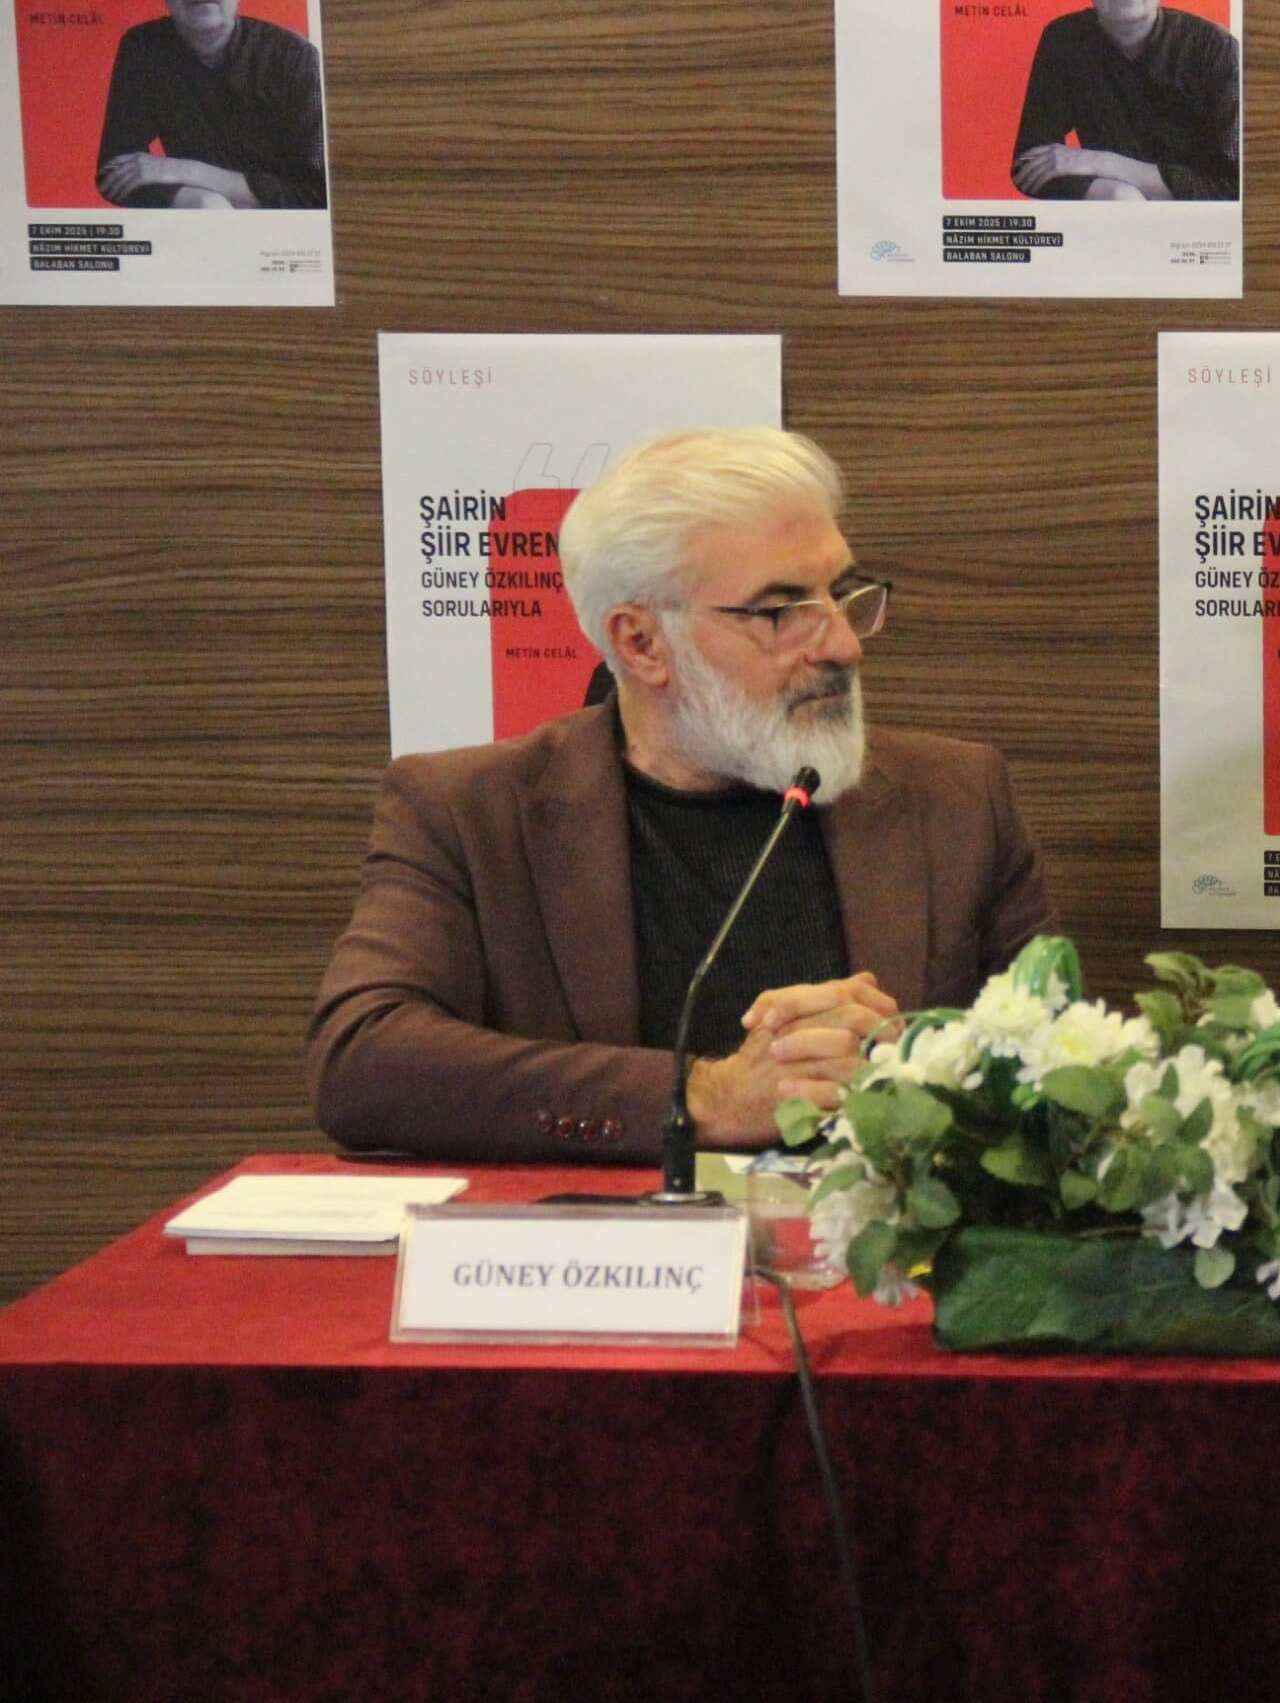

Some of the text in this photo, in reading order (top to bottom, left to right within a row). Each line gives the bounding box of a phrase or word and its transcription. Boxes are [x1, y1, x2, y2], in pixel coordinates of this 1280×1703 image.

[953, 217, 976, 227] EKİM
[978, 218, 1001, 227] 2025
[946, 234, 975, 244] NÂZIM
[977, 234, 1011, 244] HİKMET
[33, 260, 114, 269] BALABAN SALONU
[946, 251, 1025, 260] BALABAN SALONU
[408, 366, 492, 387] SÖYLEŞİ
[1188, 366, 1272, 387] SÖYLEŞİ
[419, 489, 507, 528] ŞAİRİN
[1195, 488, 1280, 527] ŞAİRİN
[420, 525, 560, 564] ŞİİR EVREN
[1195, 525, 1245, 563] ŞİİR
[421, 567, 564, 593] GÜNEY ÖZKILINÇ
[1195, 567, 1253, 588] GÜNEY
[422, 600, 542, 617] SORULARIYLA
[505, 645, 577, 659] METİN CELÂL
[453, 1259, 703, 1294] GÜNEY ÖZKILINÇ
